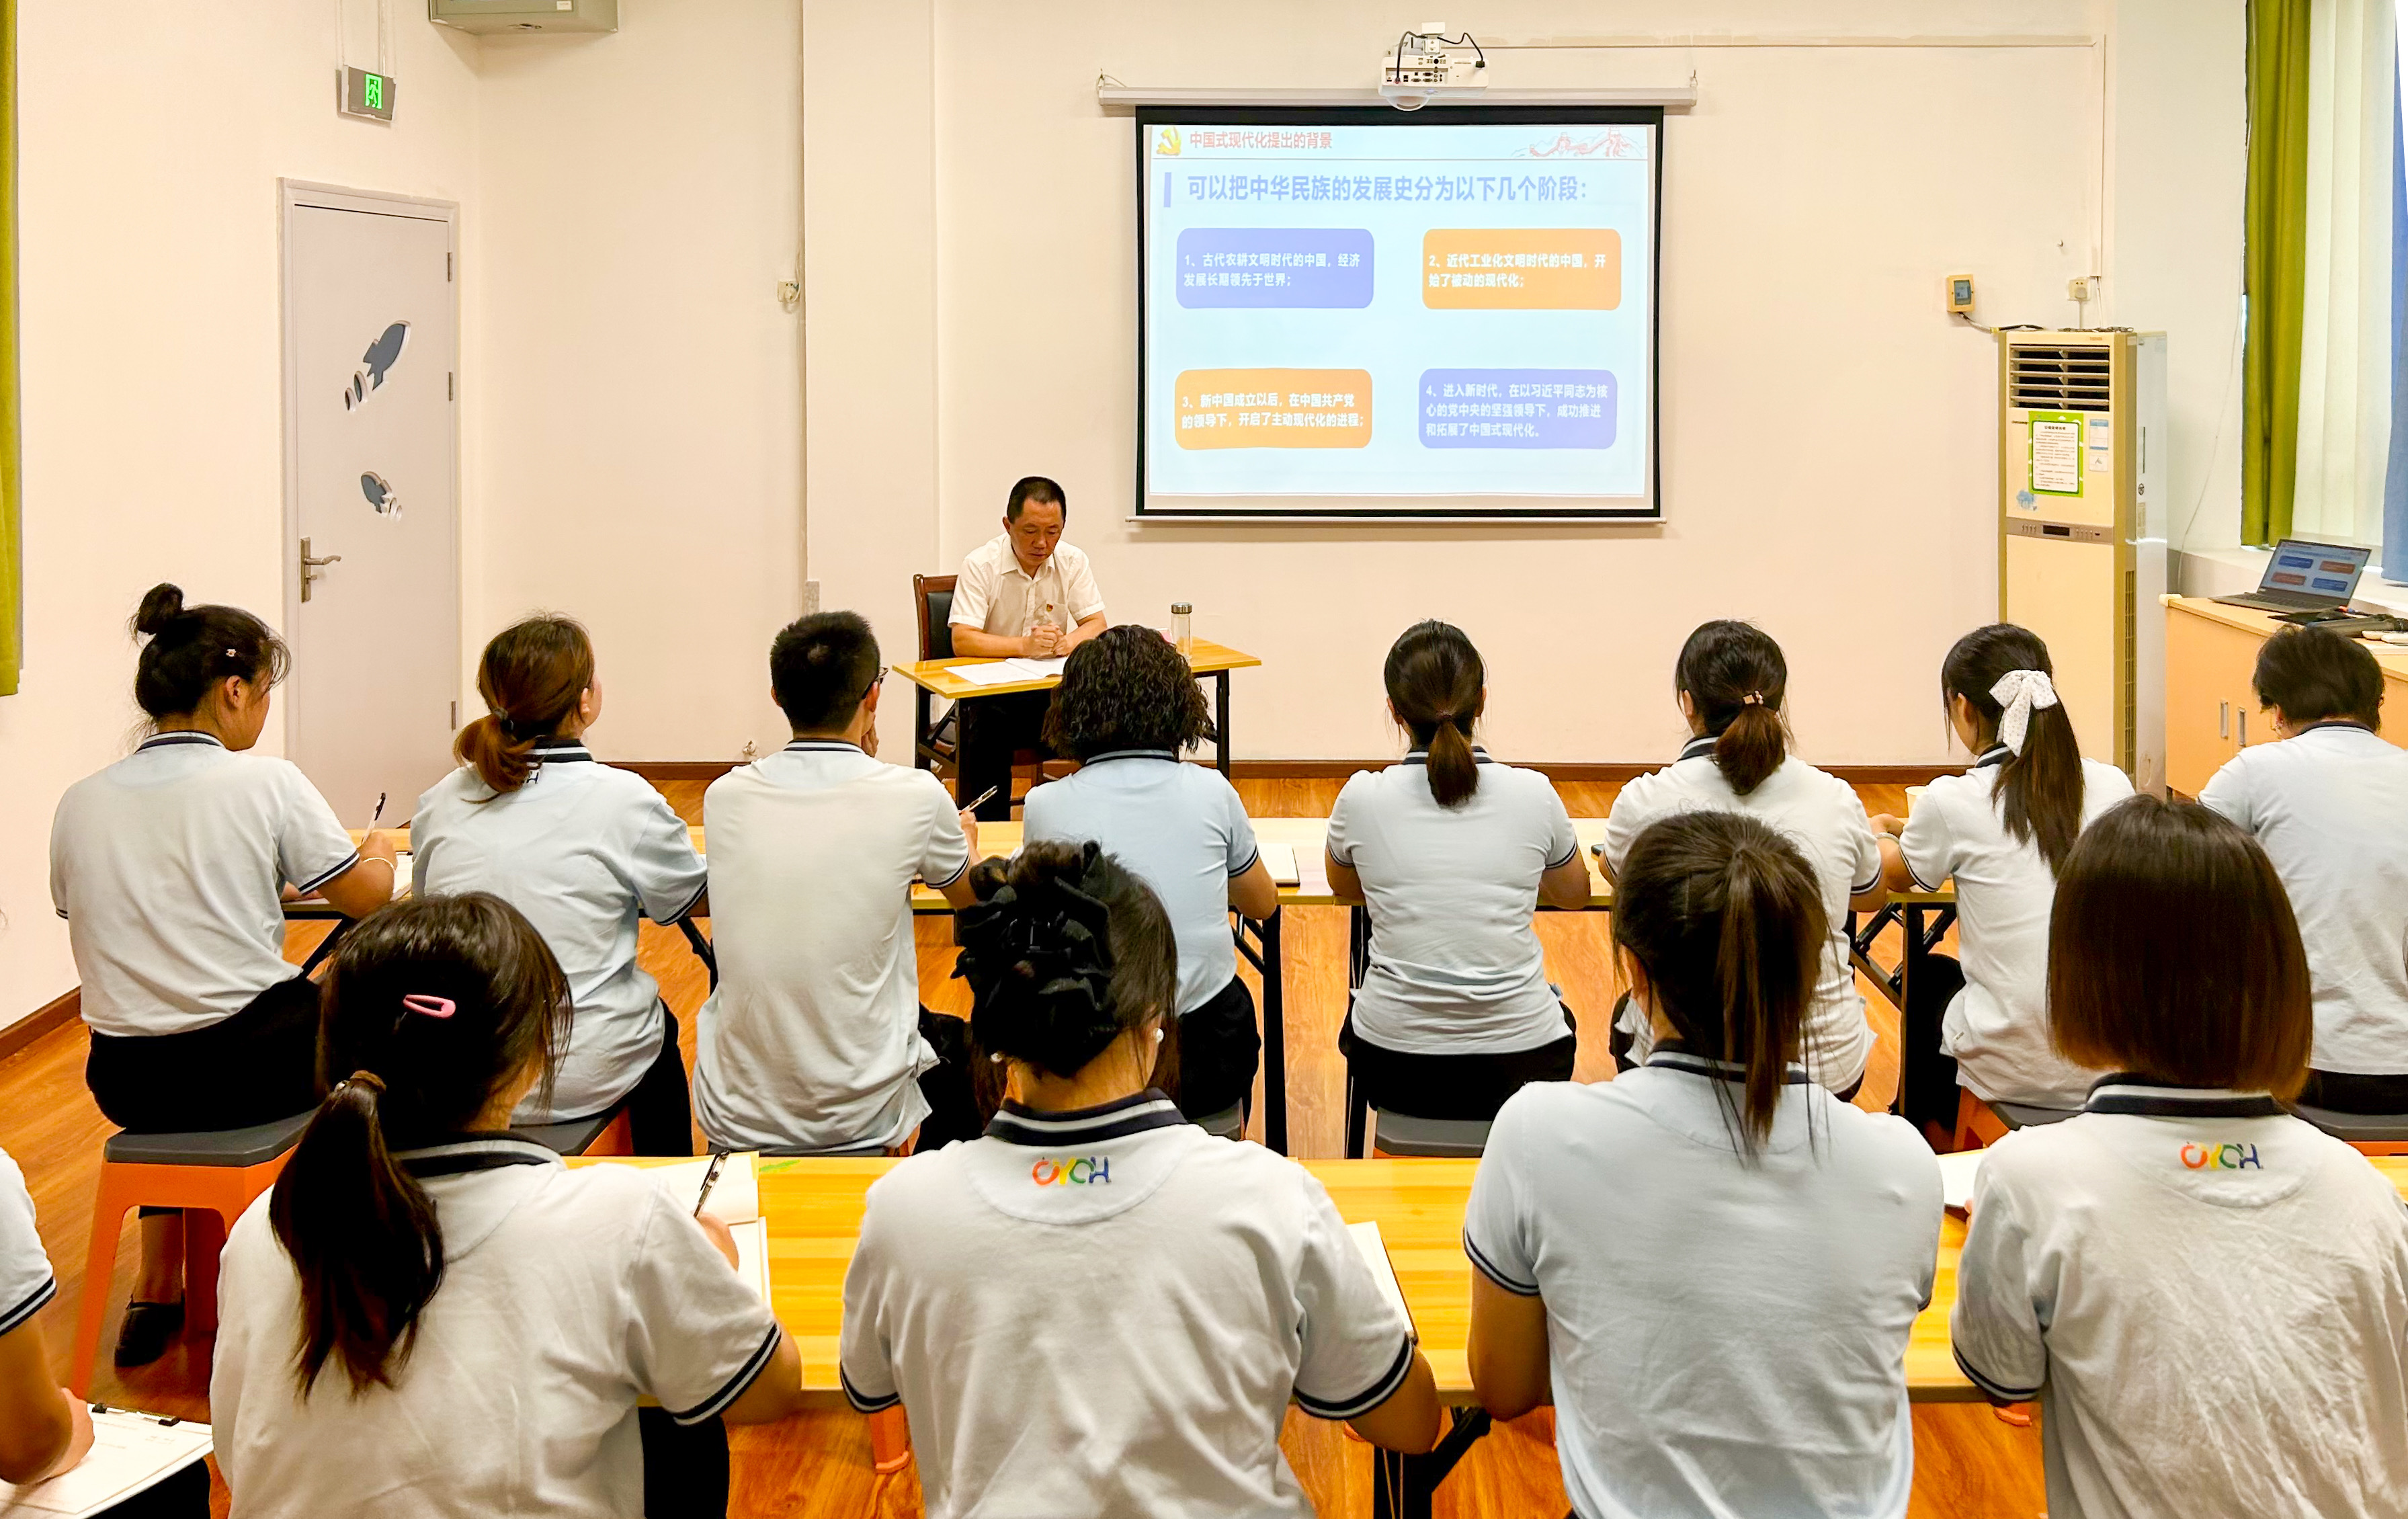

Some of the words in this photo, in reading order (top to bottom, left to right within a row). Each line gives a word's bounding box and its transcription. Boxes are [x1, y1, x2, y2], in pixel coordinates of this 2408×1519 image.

[1190, 130, 1332, 149] 中国式现代化提出的背景
